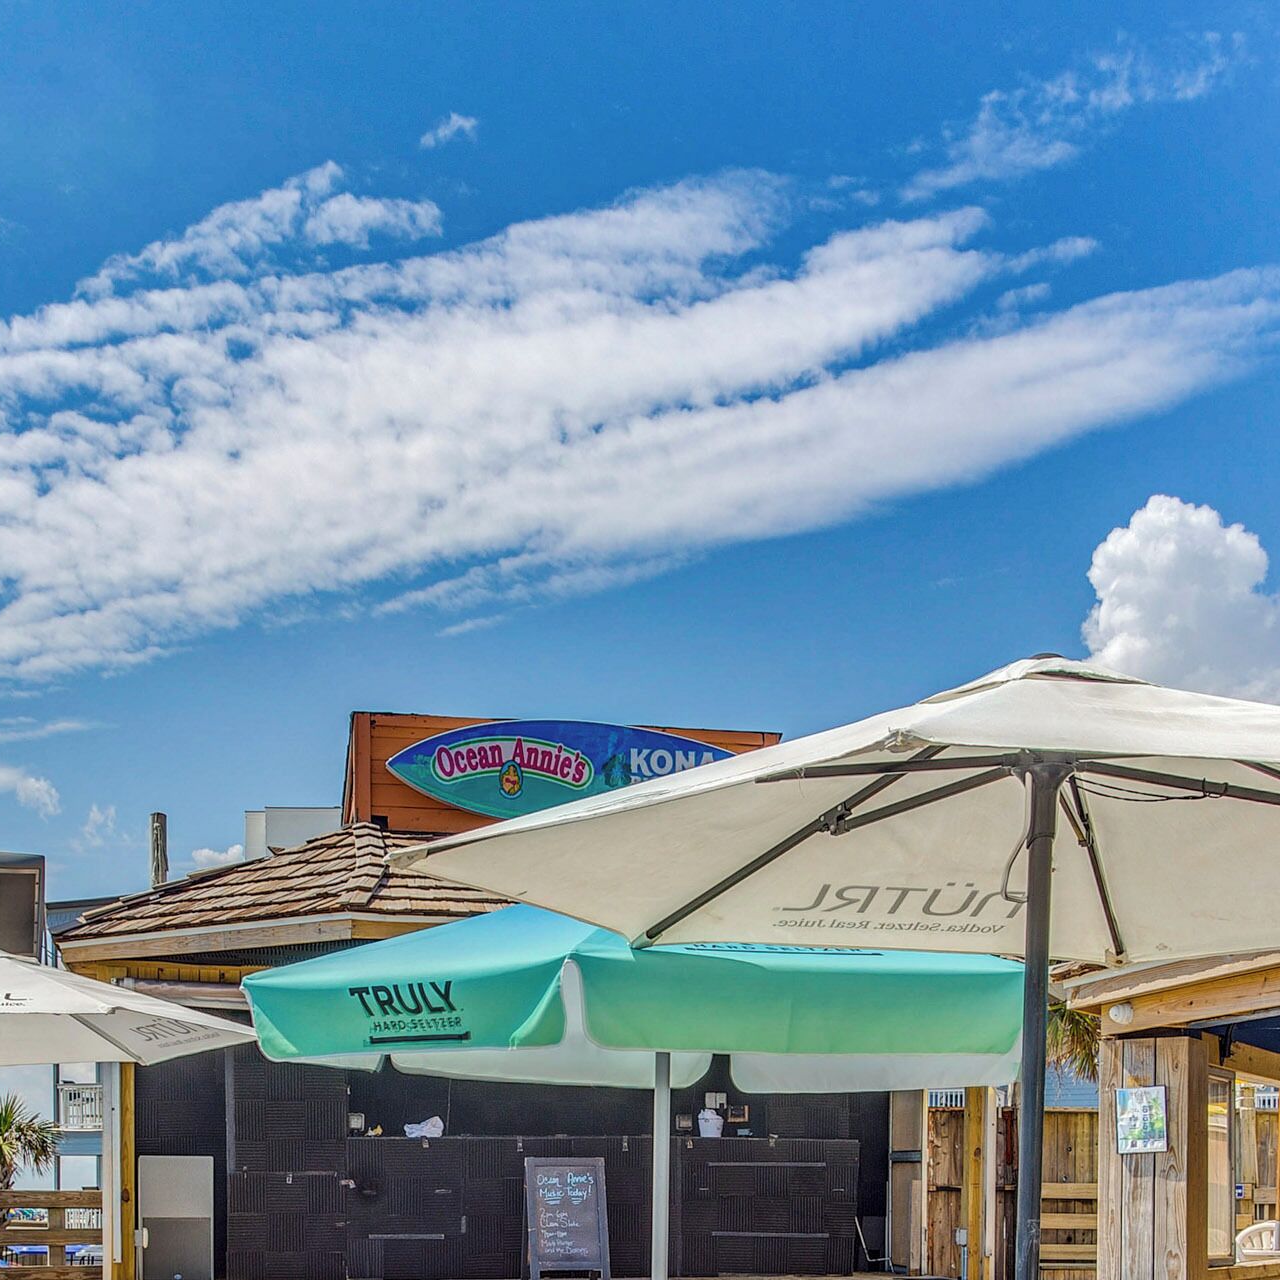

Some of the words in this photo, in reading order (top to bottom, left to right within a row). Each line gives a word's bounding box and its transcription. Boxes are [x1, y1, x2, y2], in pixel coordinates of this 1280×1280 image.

[435, 742, 504, 777] Ocean
[512, 736, 586, 784] Annie's
[348, 980, 458, 1017] TRULY
[372, 1019, 407, 1032] HARD
[409, 1016, 463, 1031] SELTZER
[567, 1172, 594, 1187] Annie's
[539, 1187, 565, 1198] Music
[563, 1185, 592, 1200] Today!
